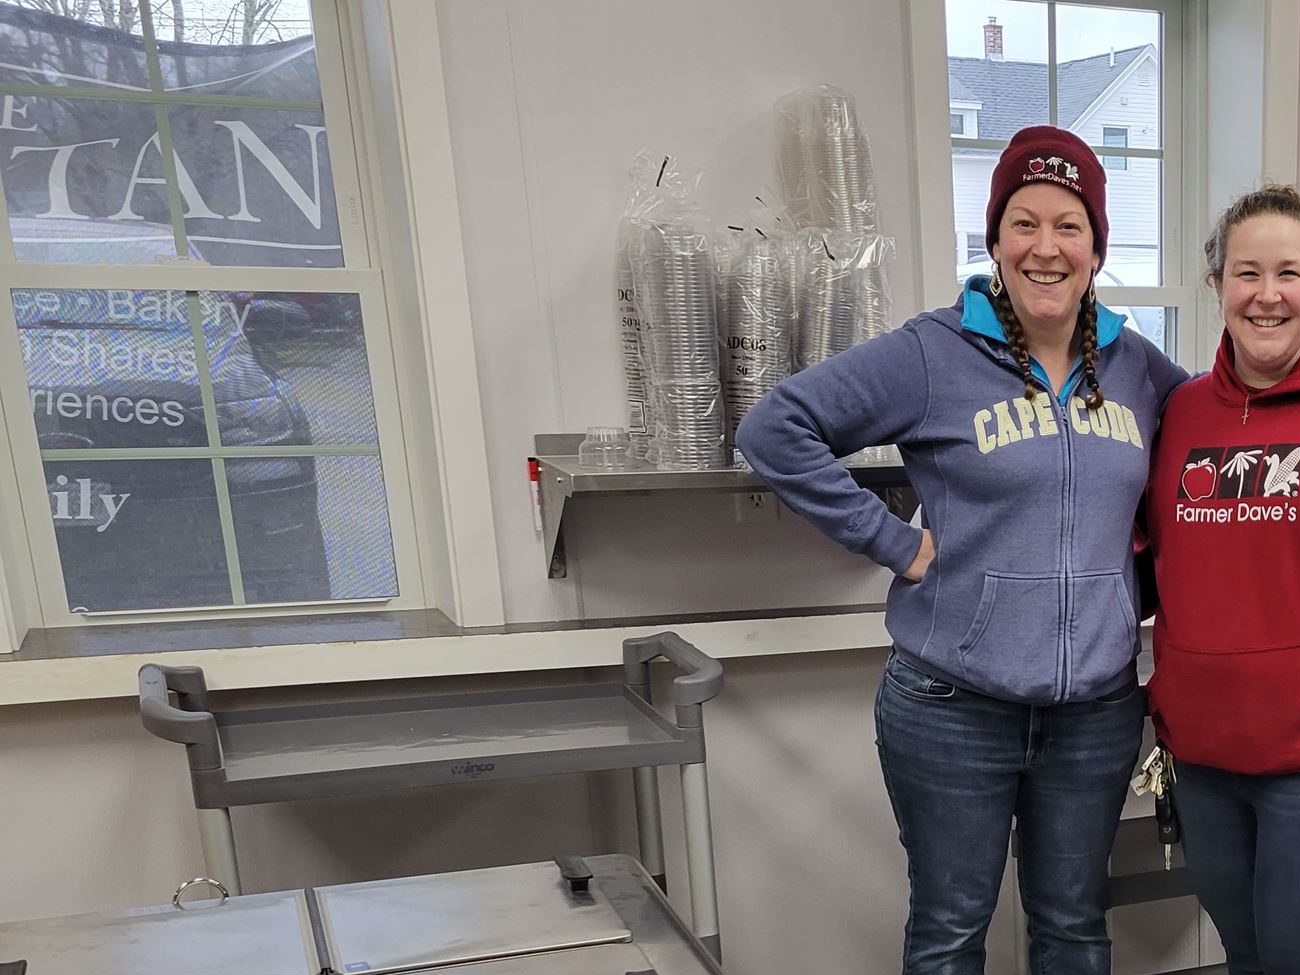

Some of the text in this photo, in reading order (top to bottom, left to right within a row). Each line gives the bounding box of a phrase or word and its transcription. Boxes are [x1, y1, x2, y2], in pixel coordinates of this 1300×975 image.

[31, 388, 185, 427] riences
[973, 392, 1059, 454] CAPE
[52, 474, 131, 532] ily
[1176, 502, 1297, 523] Farmer Dave's
